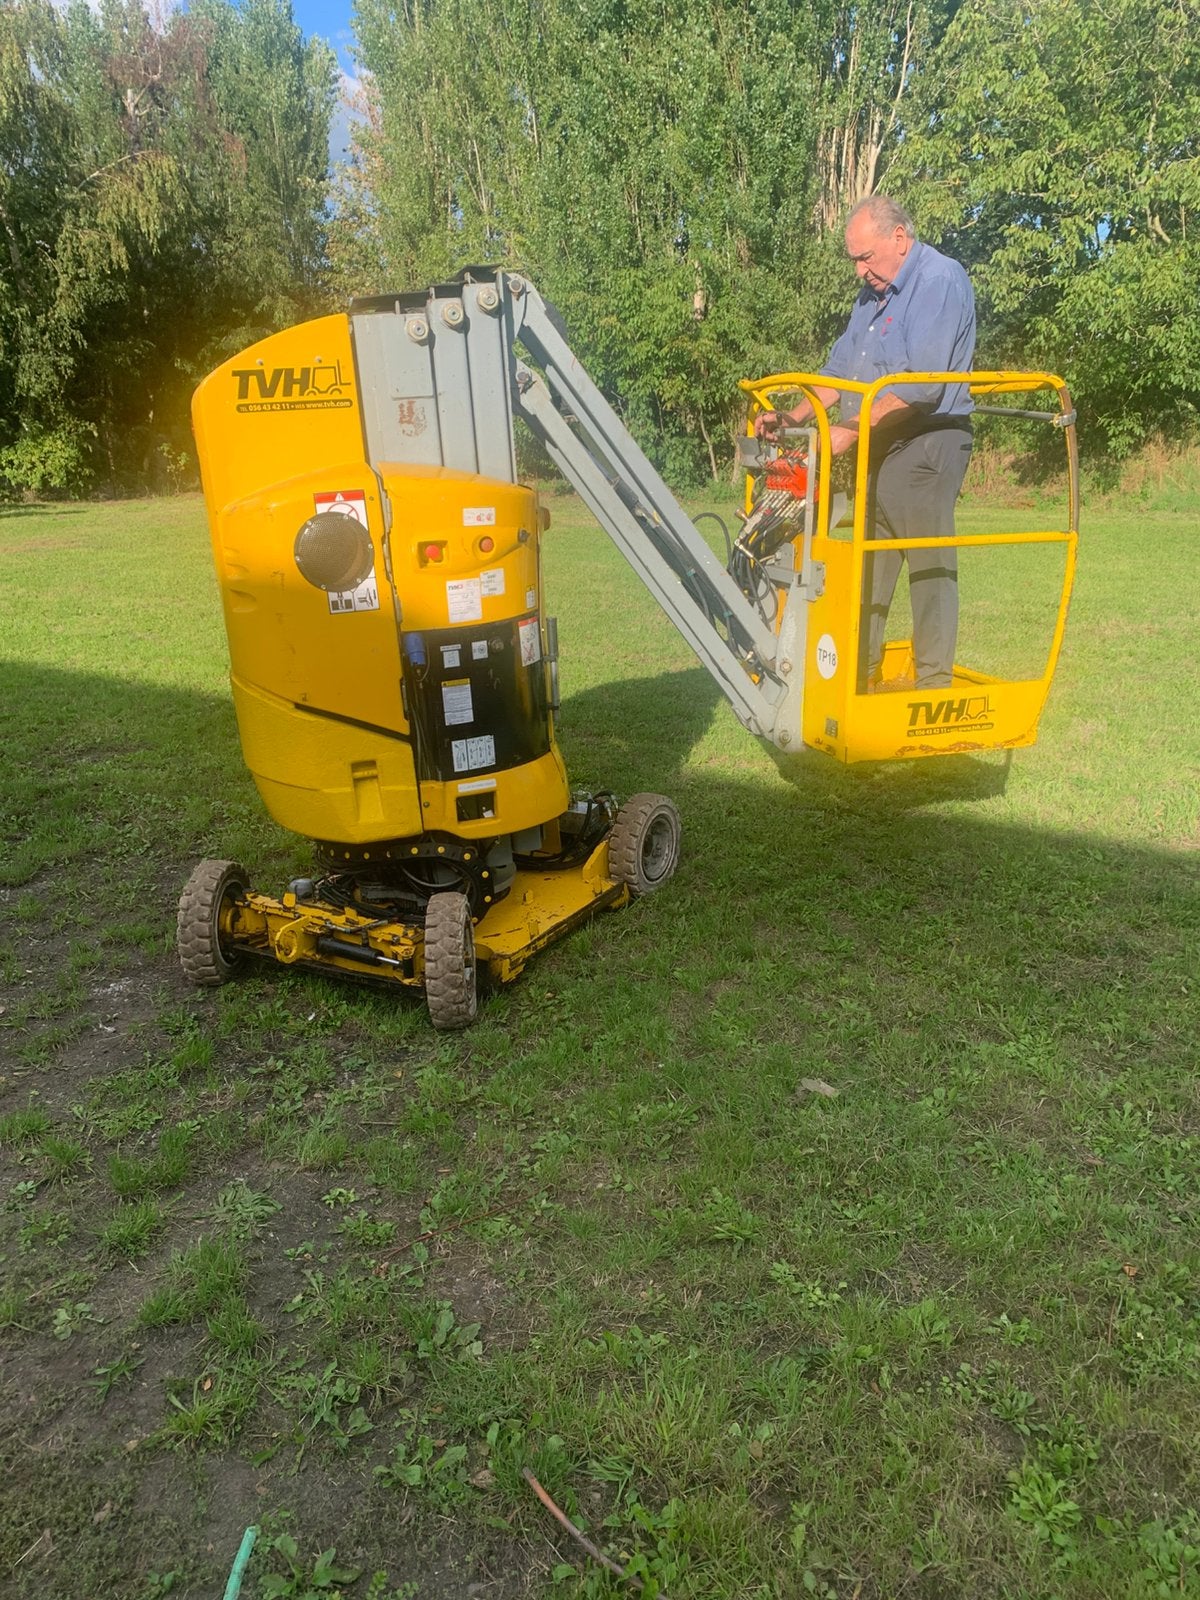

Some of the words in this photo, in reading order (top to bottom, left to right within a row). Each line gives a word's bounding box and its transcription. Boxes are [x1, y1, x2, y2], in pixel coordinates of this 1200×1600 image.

[232, 367, 311, 400] TVH
[818, 648, 836, 667] TP18
[907, 698, 968, 727] TVH
